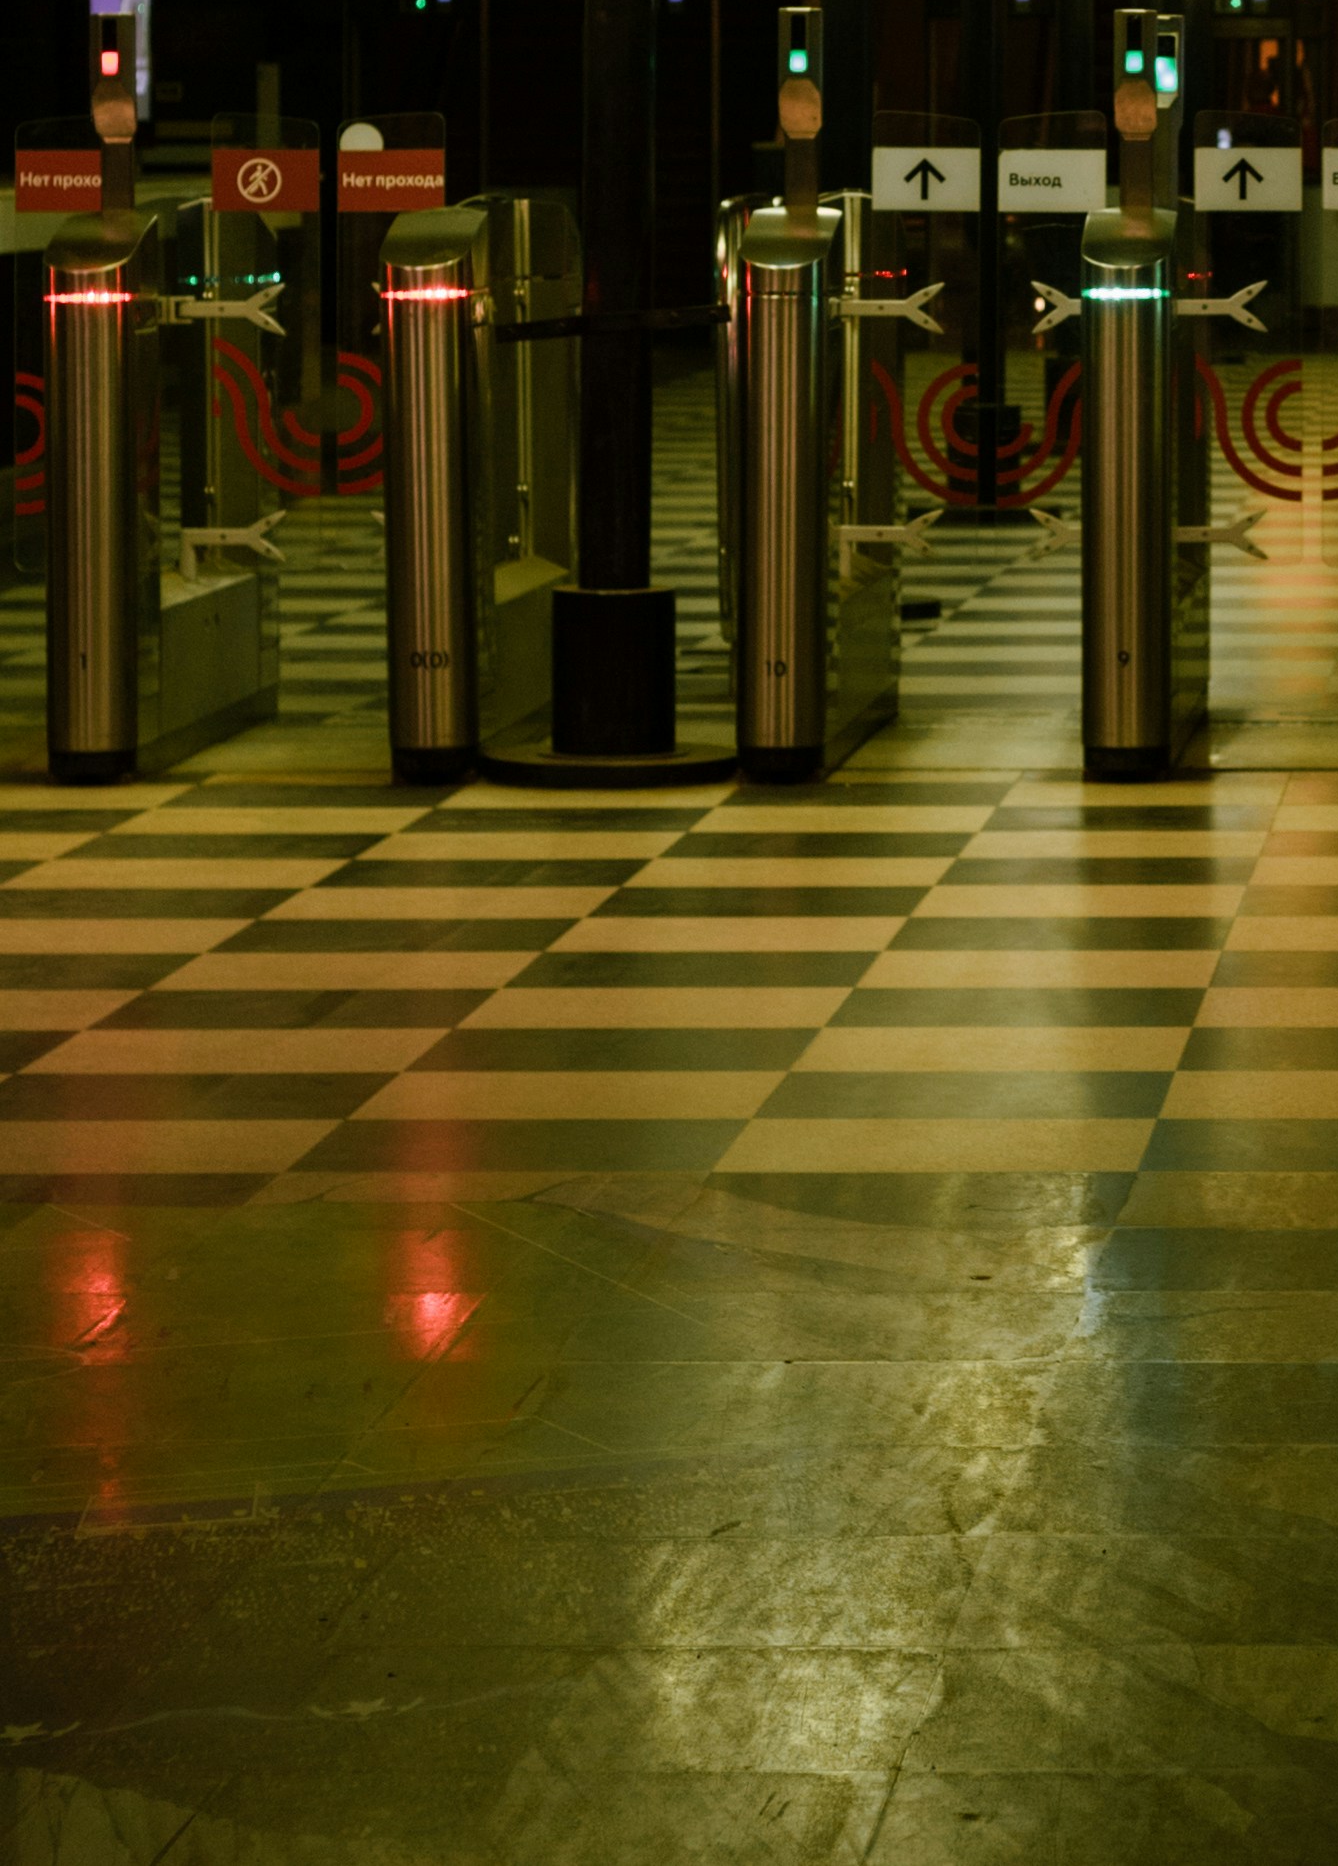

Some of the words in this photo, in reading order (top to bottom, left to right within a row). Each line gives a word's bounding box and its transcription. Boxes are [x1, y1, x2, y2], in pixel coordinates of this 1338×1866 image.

[20, 172, 50, 188] Нет
[53, 174, 102, 190] прохо
[342, 172, 373, 188] Нет
[375, 174, 444, 190] прохода
[1009, 173, 1062, 188] Выход
[1117, 650, 1130, 668] 9
[766, 660, 787, 677] 10
